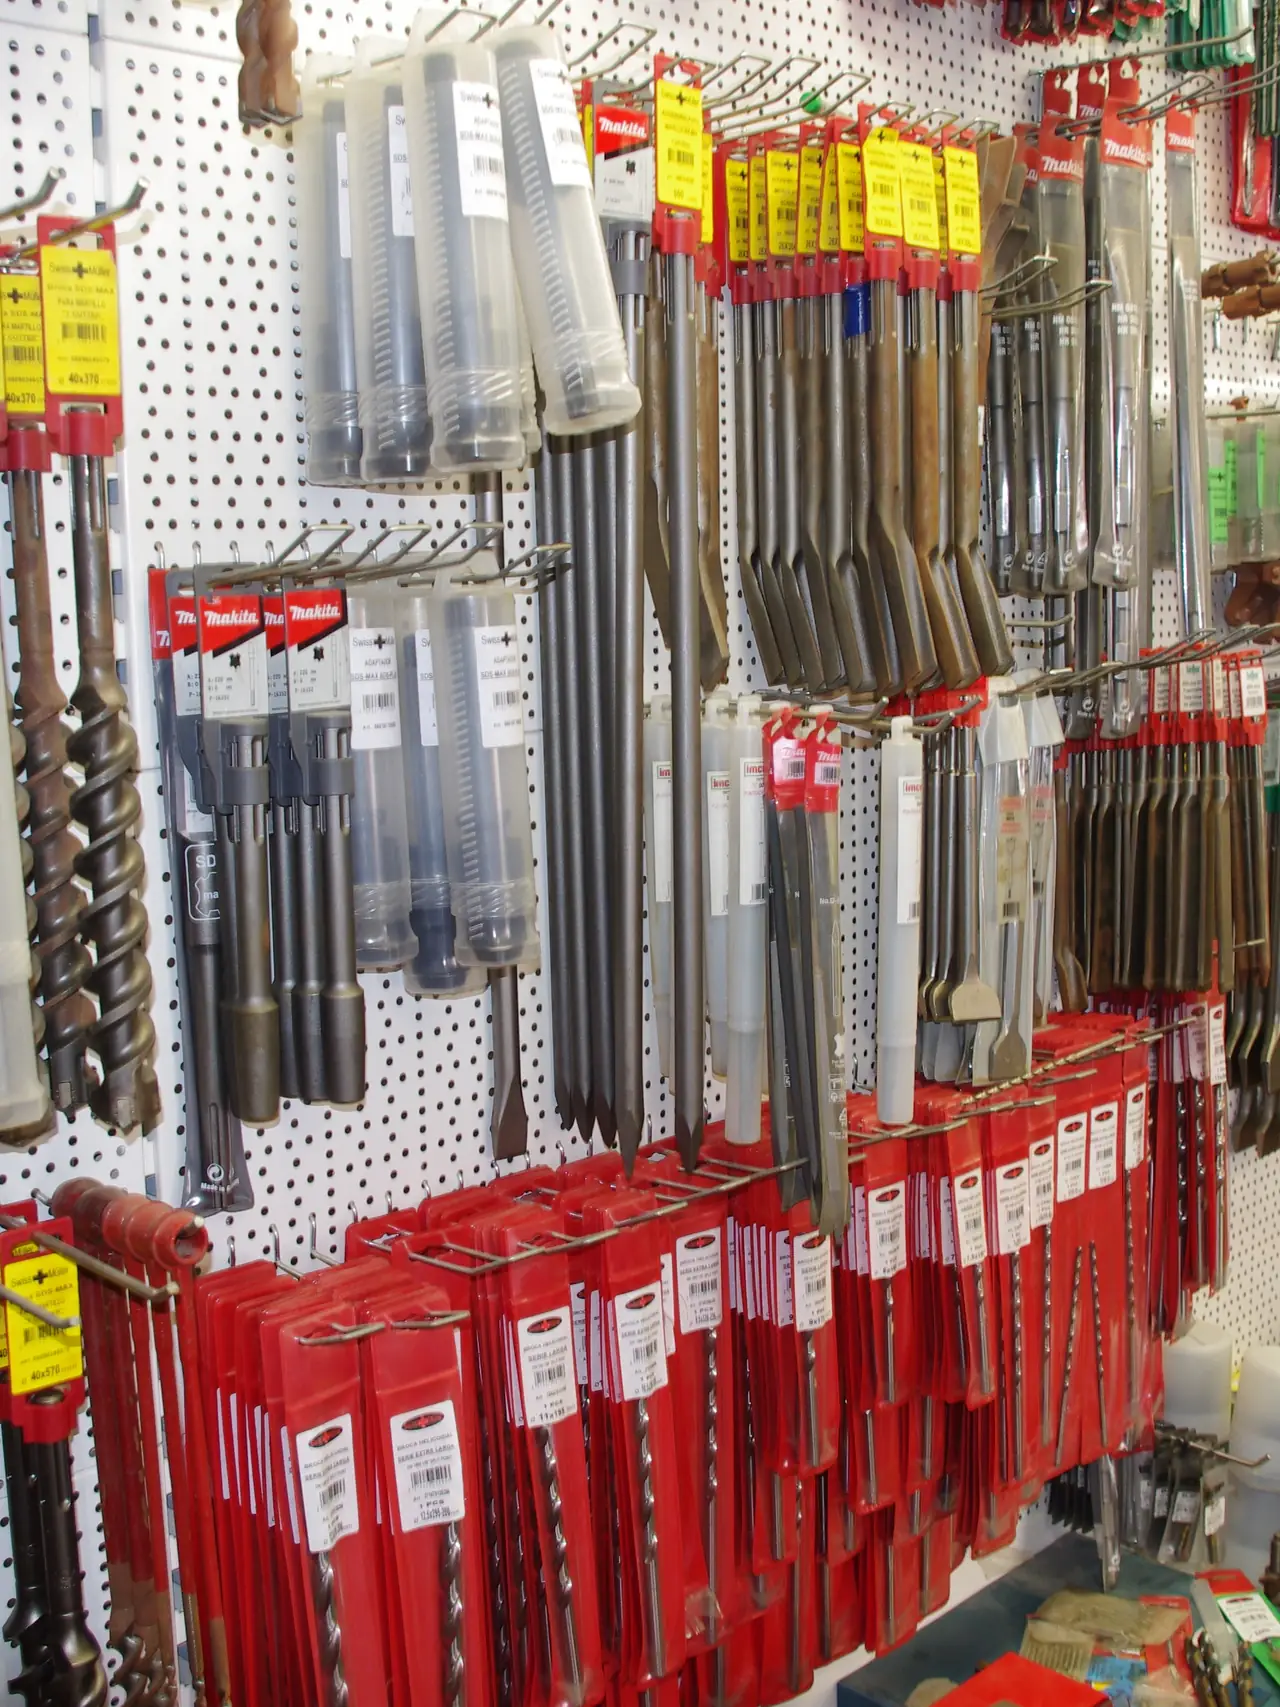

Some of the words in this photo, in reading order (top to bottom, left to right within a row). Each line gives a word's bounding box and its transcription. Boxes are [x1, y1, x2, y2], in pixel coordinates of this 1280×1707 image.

[68, 372, 100, 385] 40x370
[352, 635, 374, 647] Swiss
[481, 635, 501, 646] Swiss
[195, 854, 216, 868] SD
[203, 891, 219, 899] ma
[11, 1276, 33, 1288] Swiss
[30, 1365, 61, 1382] 40x570
